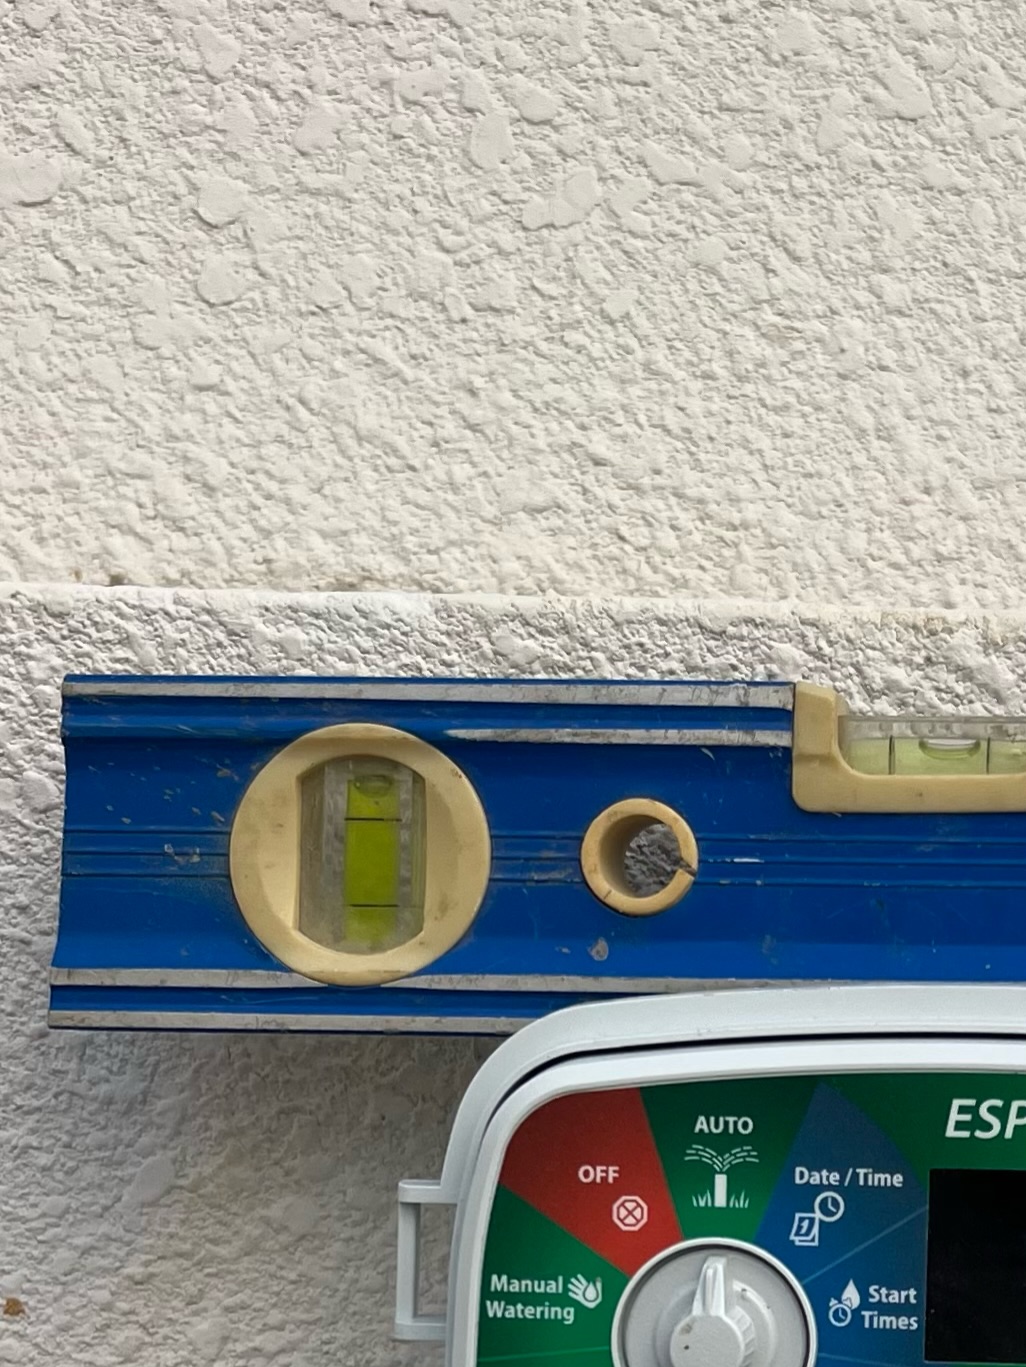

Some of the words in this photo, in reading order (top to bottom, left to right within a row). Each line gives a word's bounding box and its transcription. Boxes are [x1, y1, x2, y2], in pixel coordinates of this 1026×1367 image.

[695, 1116, 753, 1134] AUTO
[578, 1165, 619, 1183] OFF
[795, 1167, 840, 1185] Date
[856, 1169, 903, 1187] Time
[491, 1274, 563, 1293] Manual
[869, 1285, 916, 1303] Start
[486, 1301, 575, 1324] Watering
[861, 1311, 918, 1330] Times
